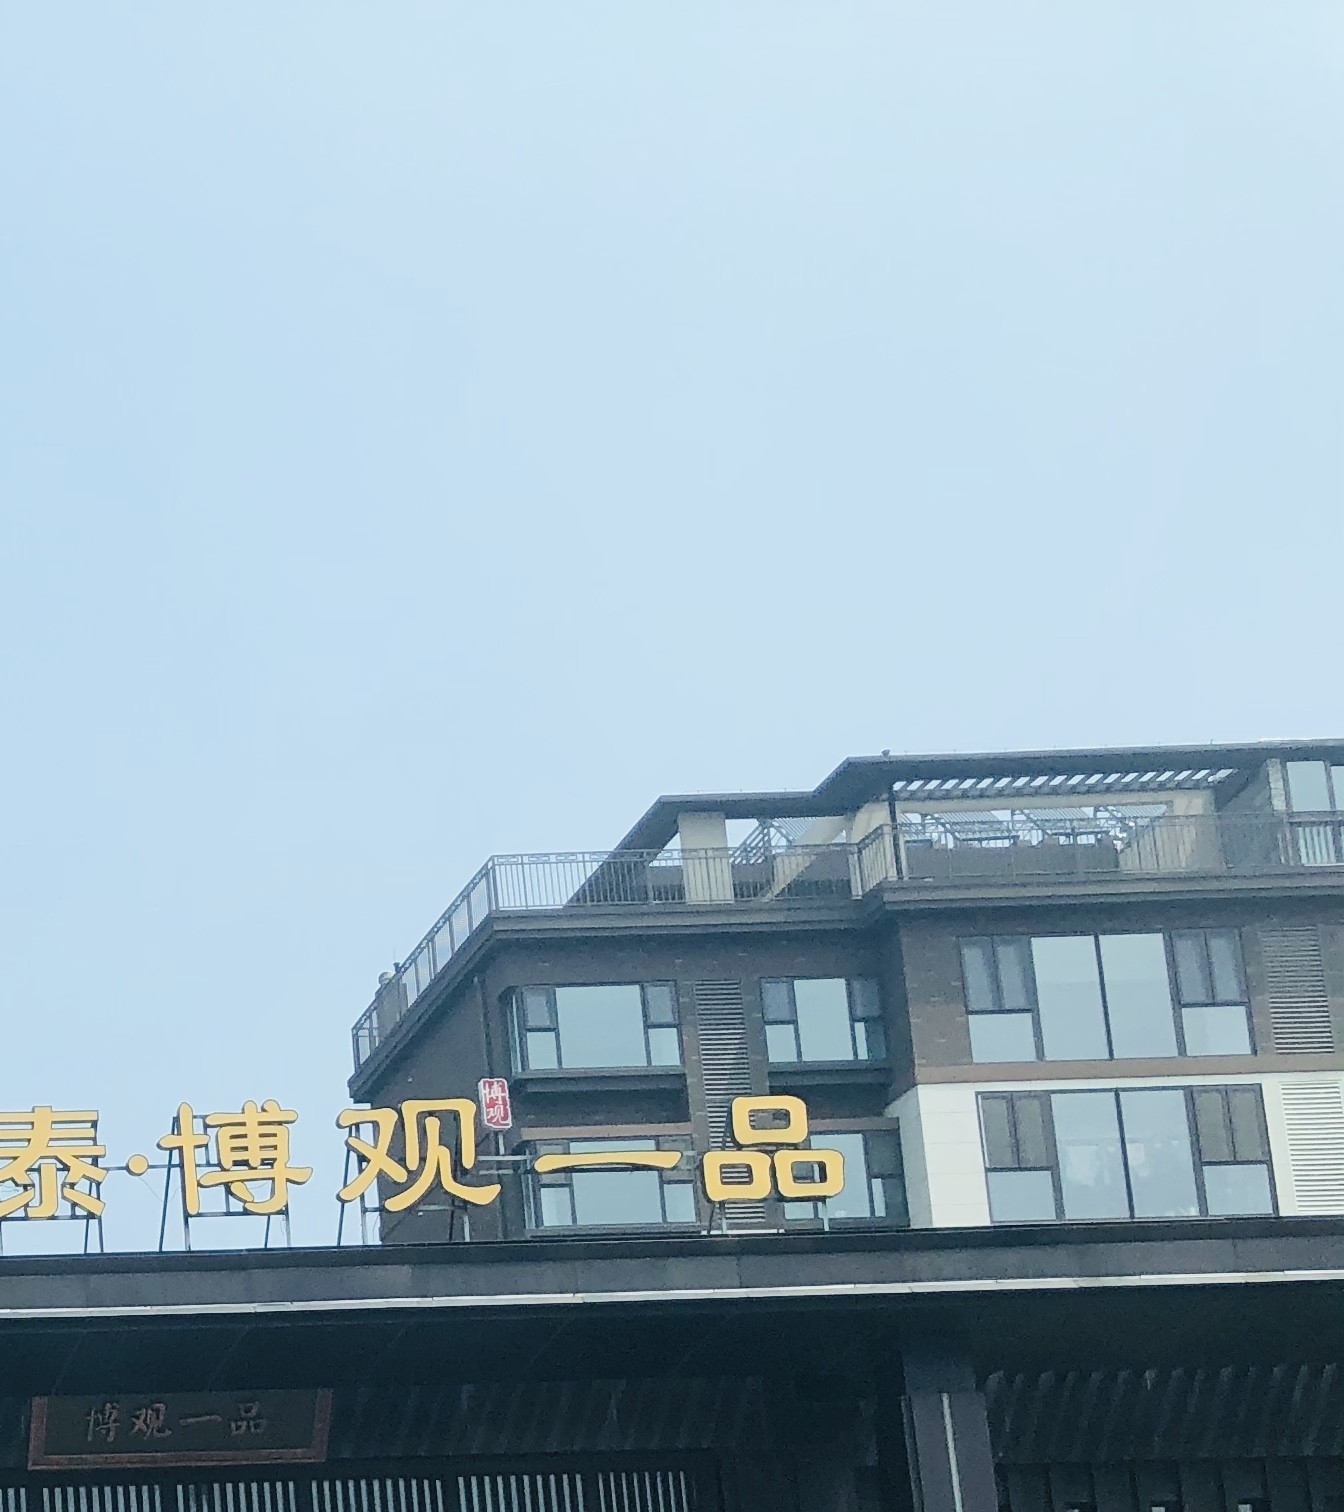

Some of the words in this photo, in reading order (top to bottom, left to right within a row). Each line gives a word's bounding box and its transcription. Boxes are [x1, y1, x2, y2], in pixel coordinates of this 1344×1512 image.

[483, 1081, 511, 1124] 博观
[85, 1400, 269, 1443] 博观一品
